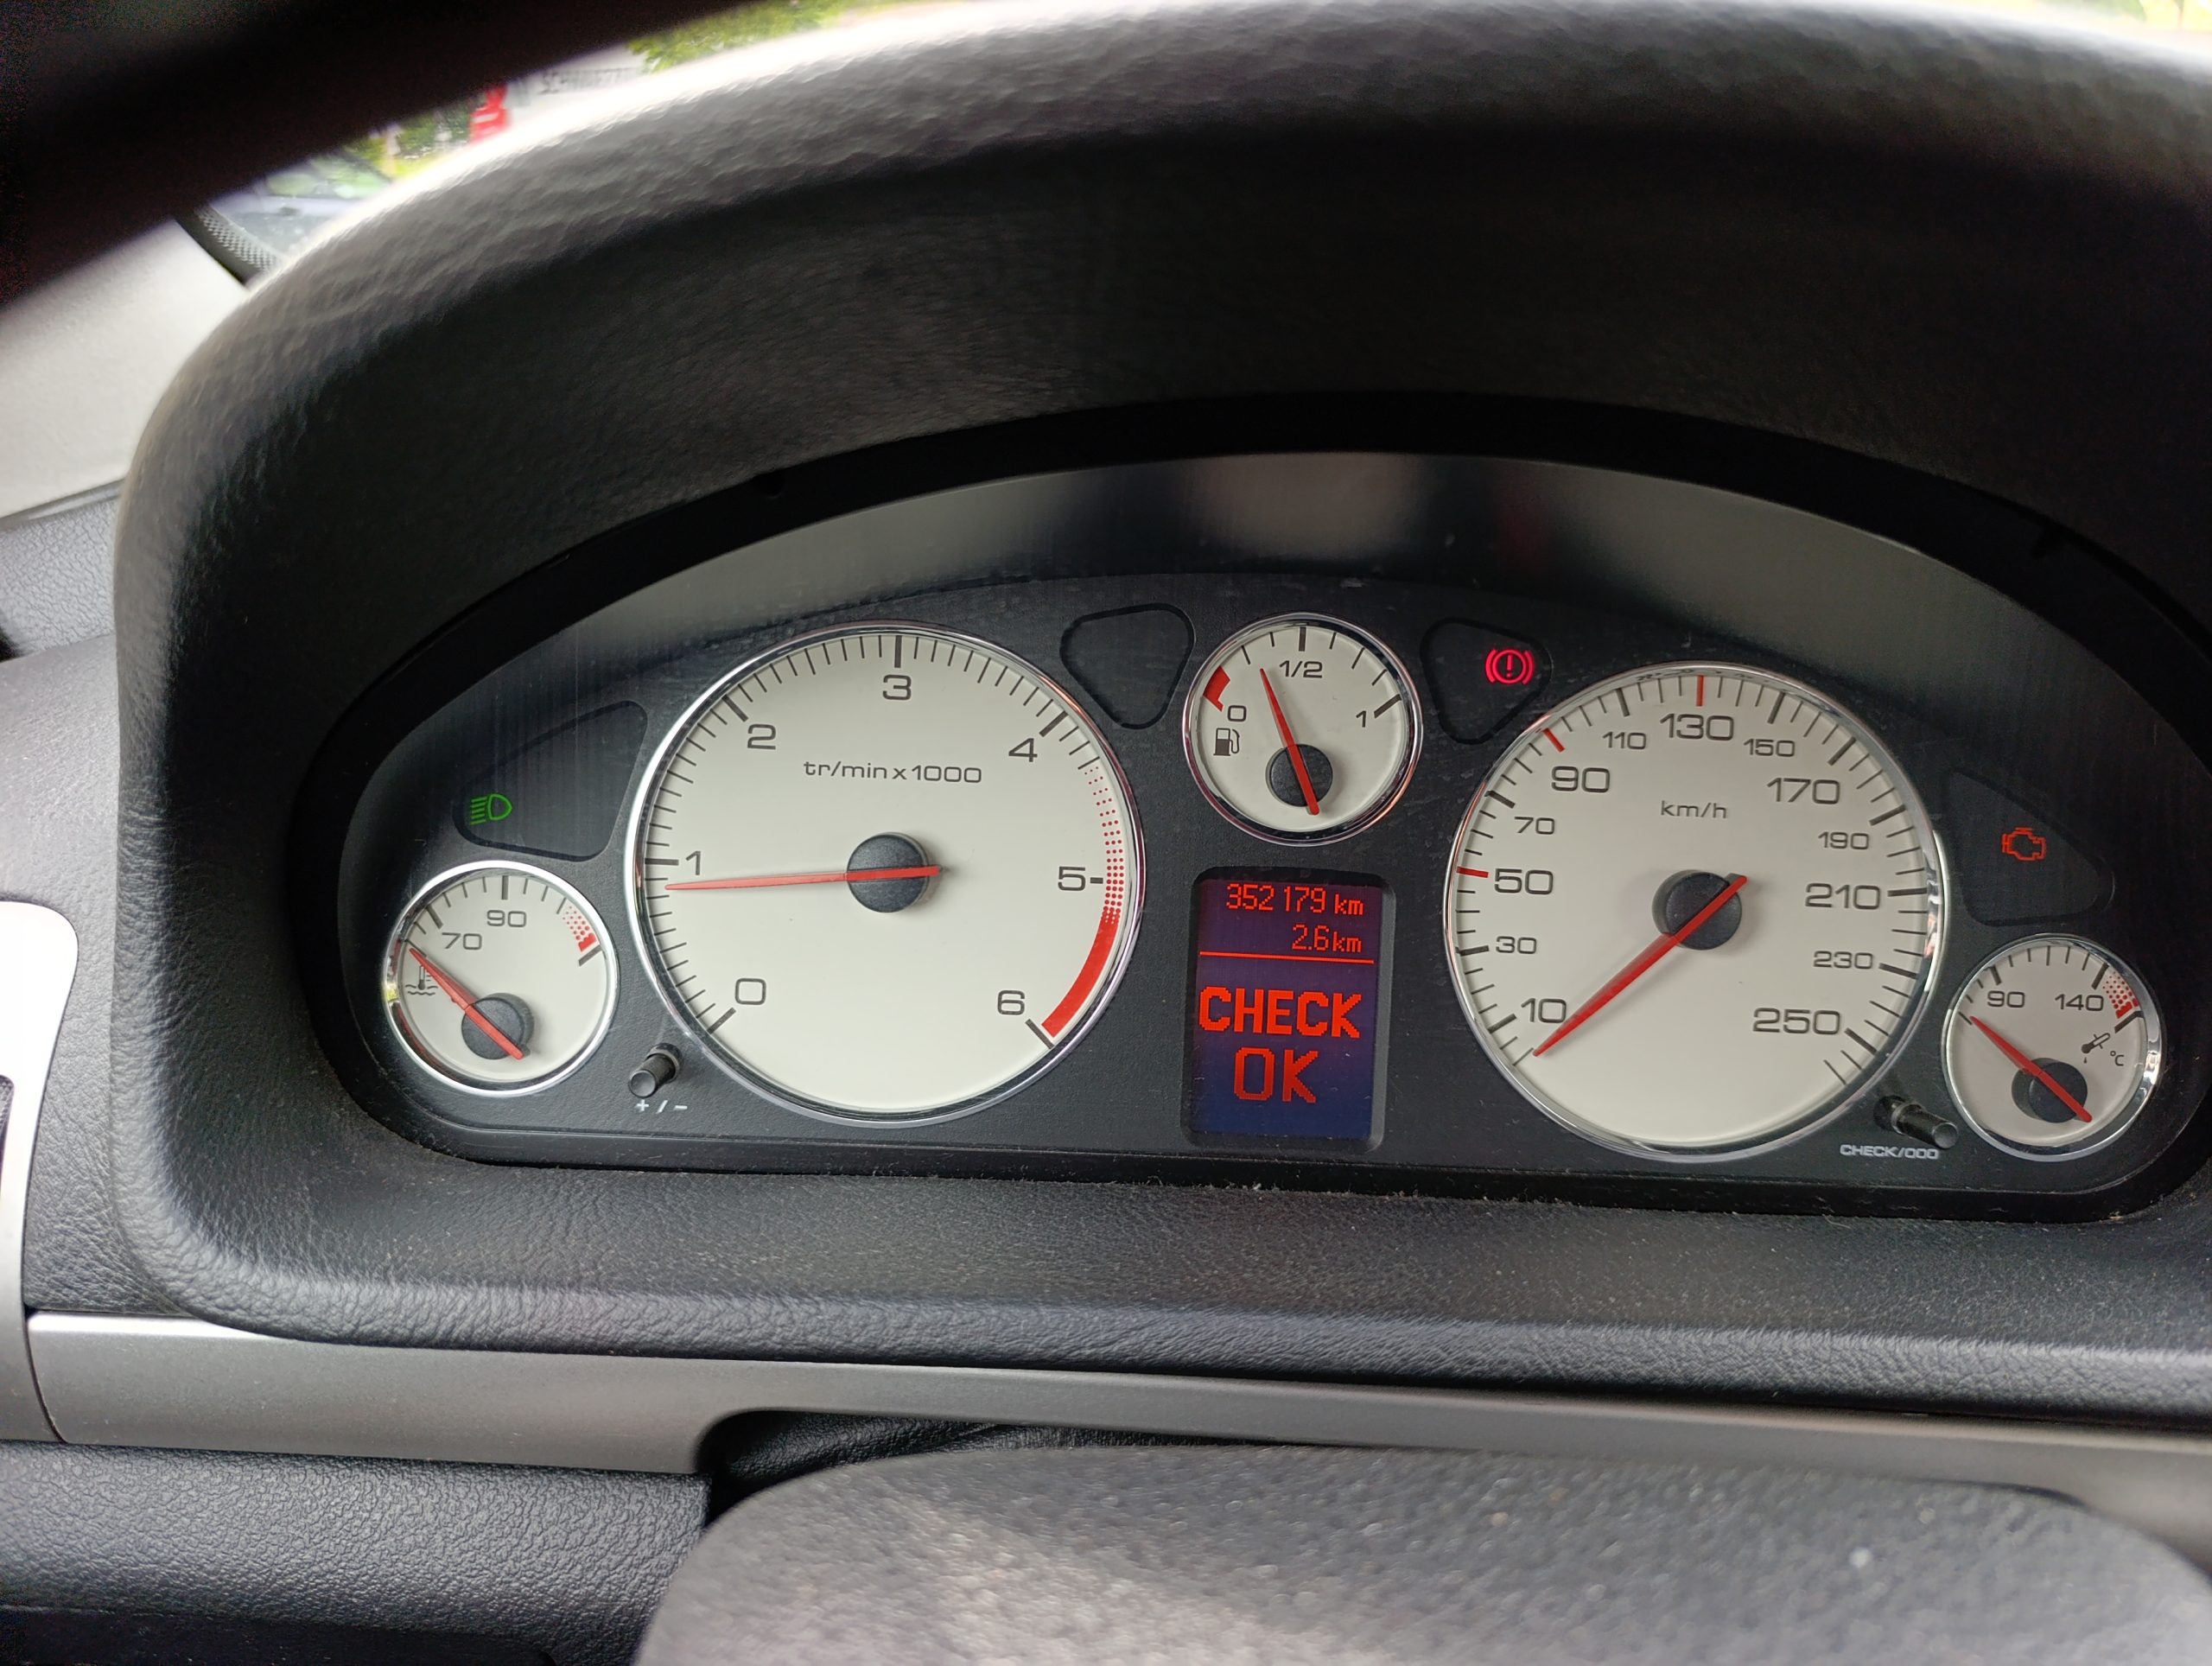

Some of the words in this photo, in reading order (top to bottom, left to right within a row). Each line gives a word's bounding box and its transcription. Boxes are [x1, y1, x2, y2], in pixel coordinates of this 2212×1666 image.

[1279, 659, 1323, 679] 1/2
[882, 674, 912, 701] 3
[1227, 704, 1248, 722] 0
[1355, 710, 1367, 728] 1
[747, 723, 777, 750] 2
[1660, 713, 1735, 741] 130
[1007, 737, 1038, 763] 4
[1602, 731, 1647, 750] 110
[1743, 738, 1796, 758] 150
[803, 760, 887, 779] tr/min
[1551, 766, 1611, 793] 90
[1766, 777, 1841, 805] 170
[1661, 800, 1727, 819] km/h
[1514, 816, 1555, 836] 70
[1818, 831, 1870, 850] 190
[685, 850, 702, 876] 1
[1058, 866, 1086, 892] 5
[1494, 868, 1554, 895] 50
[1333, 893, 1365, 916] km
[1805, 882, 1882, 911] 210
[486, 909, 527, 928] 90
[441, 932, 483, 951] 70
[1495, 935, 1537, 955] 30
[1813, 950, 1874, 970] 230
[734, 977, 767, 1006] 0
[997, 989, 1026, 1016] 6
[1986, 990, 2026, 1008] 90
[2055, 993, 2105, 1012] 140
[1198, 986, 1363, 1039] CHECK
[1520, 997, 1567, 1024] 10
[1752, 1007, 1841, 1036] 250
[1234, 1047, 1319, 1103] OK
